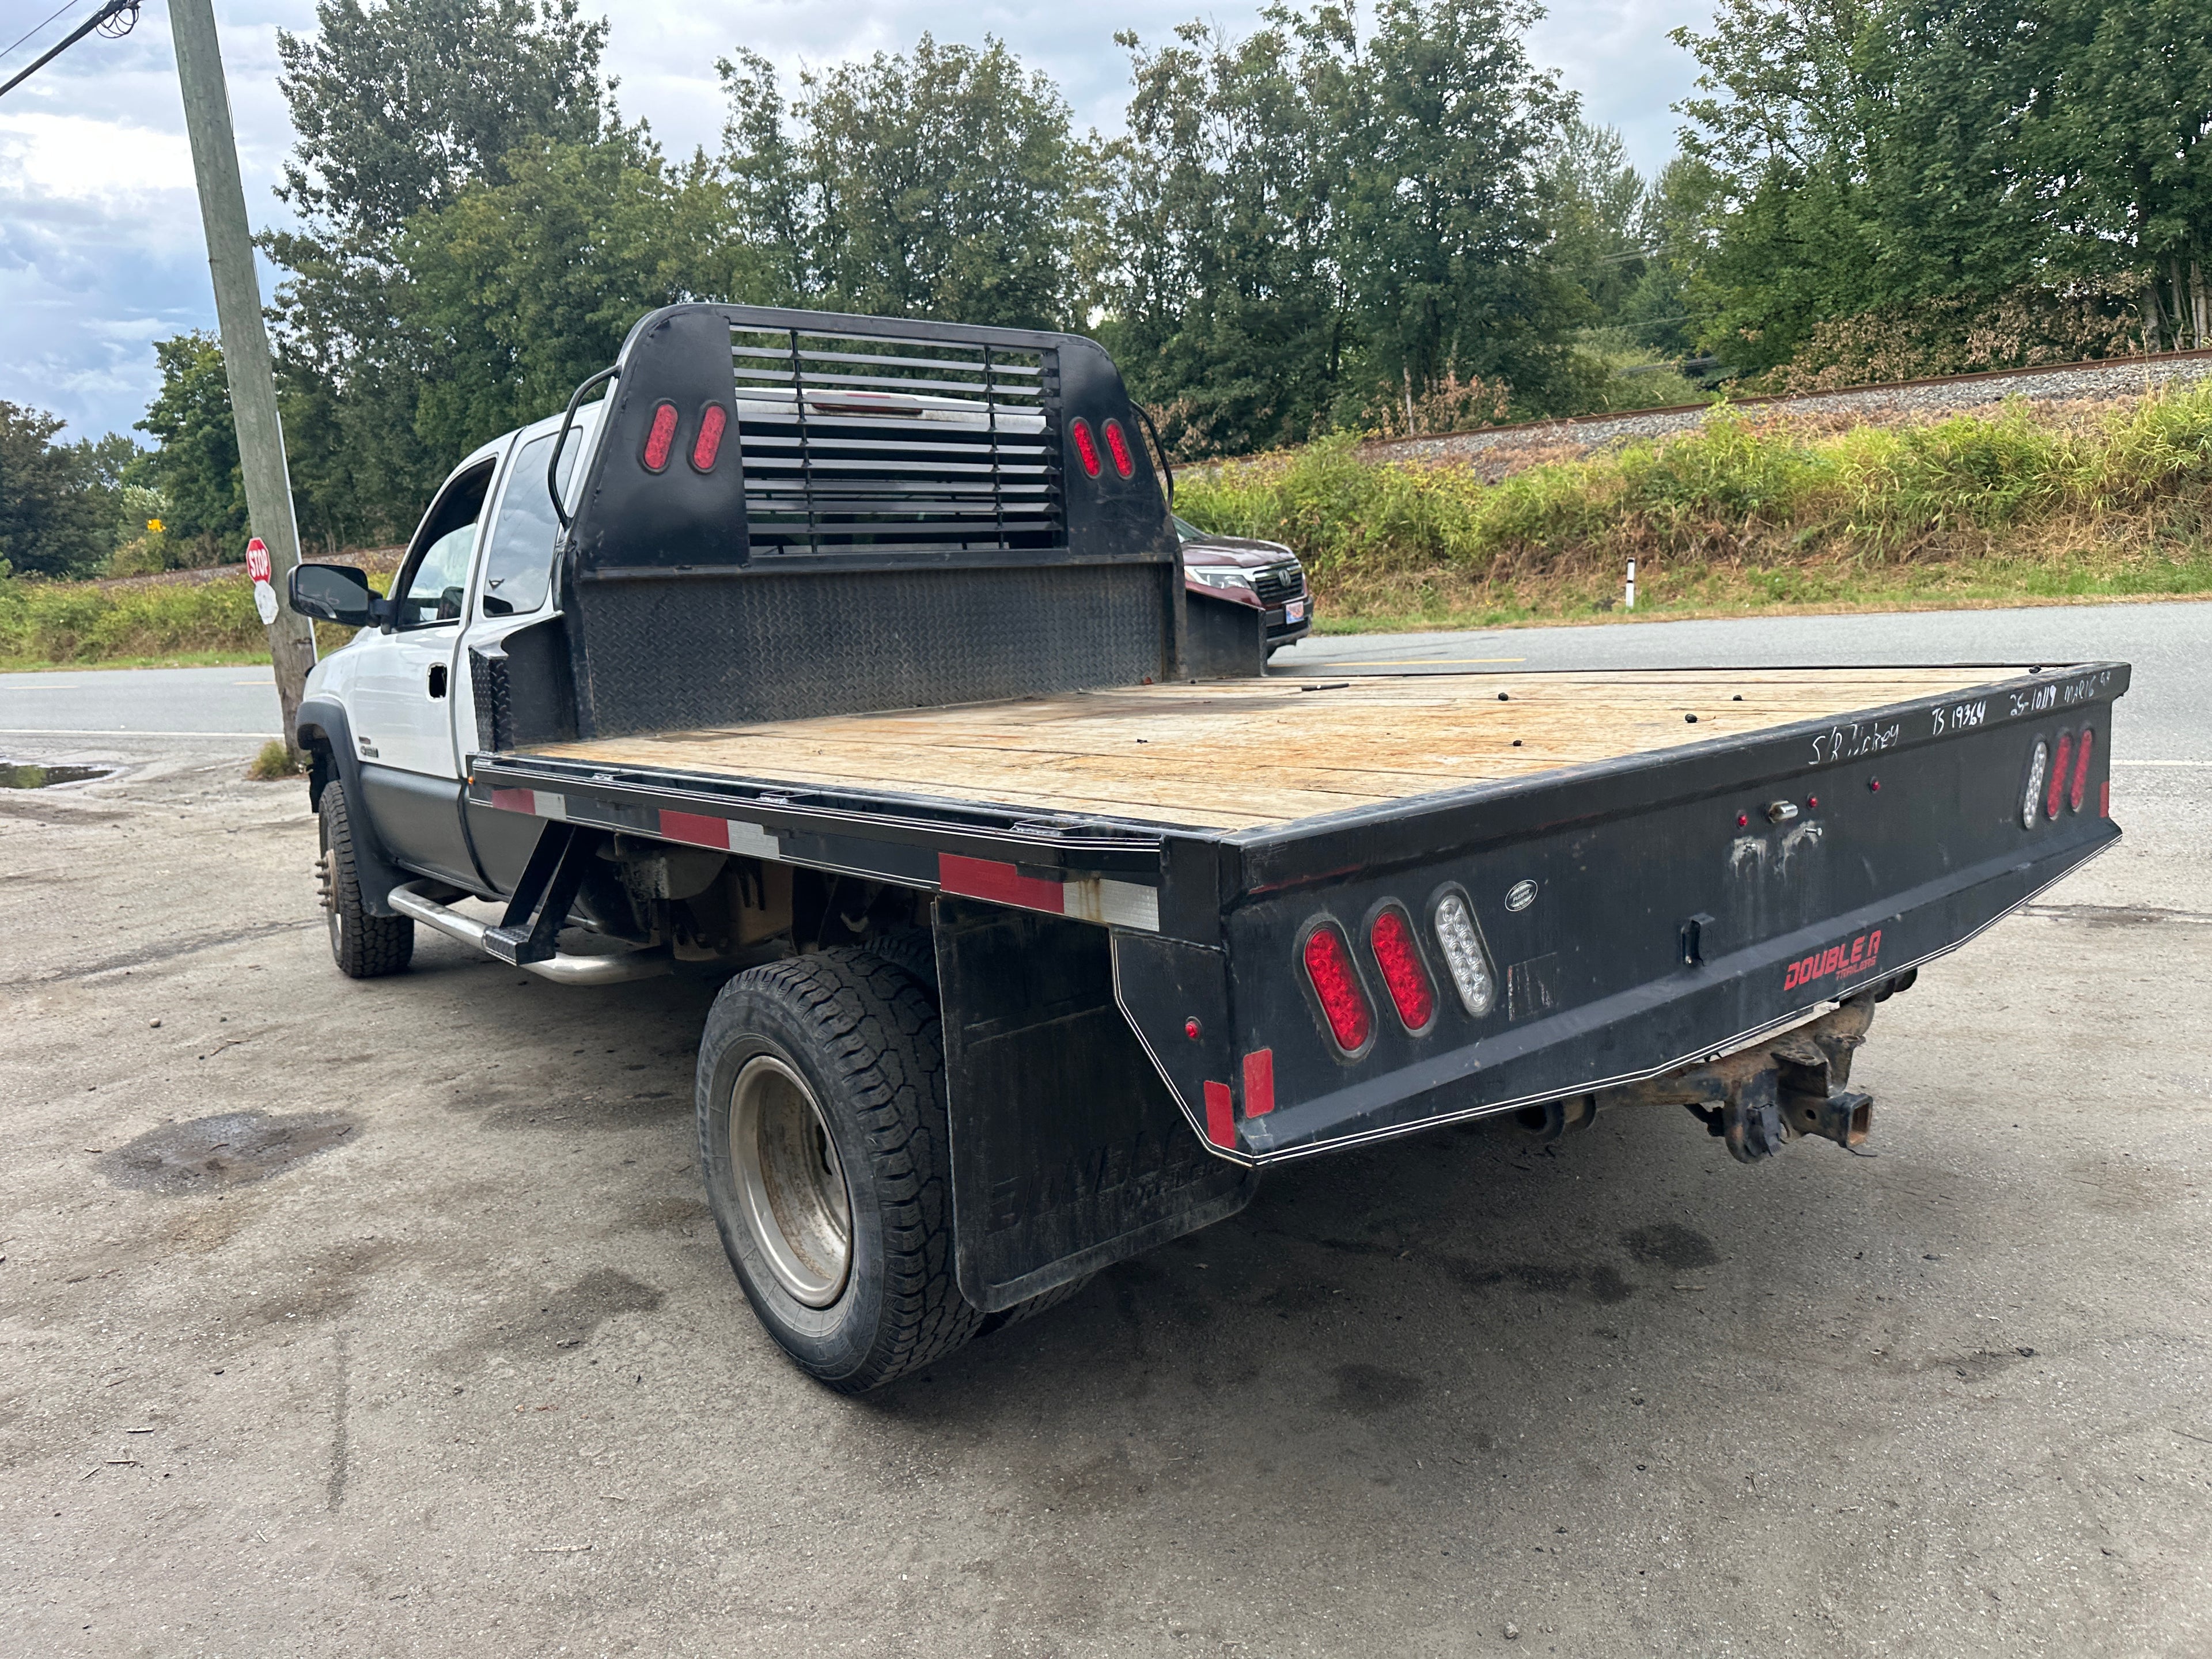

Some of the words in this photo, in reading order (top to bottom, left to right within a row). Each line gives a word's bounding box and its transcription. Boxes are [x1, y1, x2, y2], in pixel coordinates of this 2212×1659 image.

[249, 548, 268, 577] STOP
[1952, 700, 1986, 729] 19364
[1784, 935, 1865, 991] DOUBLE
[1867, 930, 1881, 957] A
[1835, 955, 1877, 981] TRAILERS
